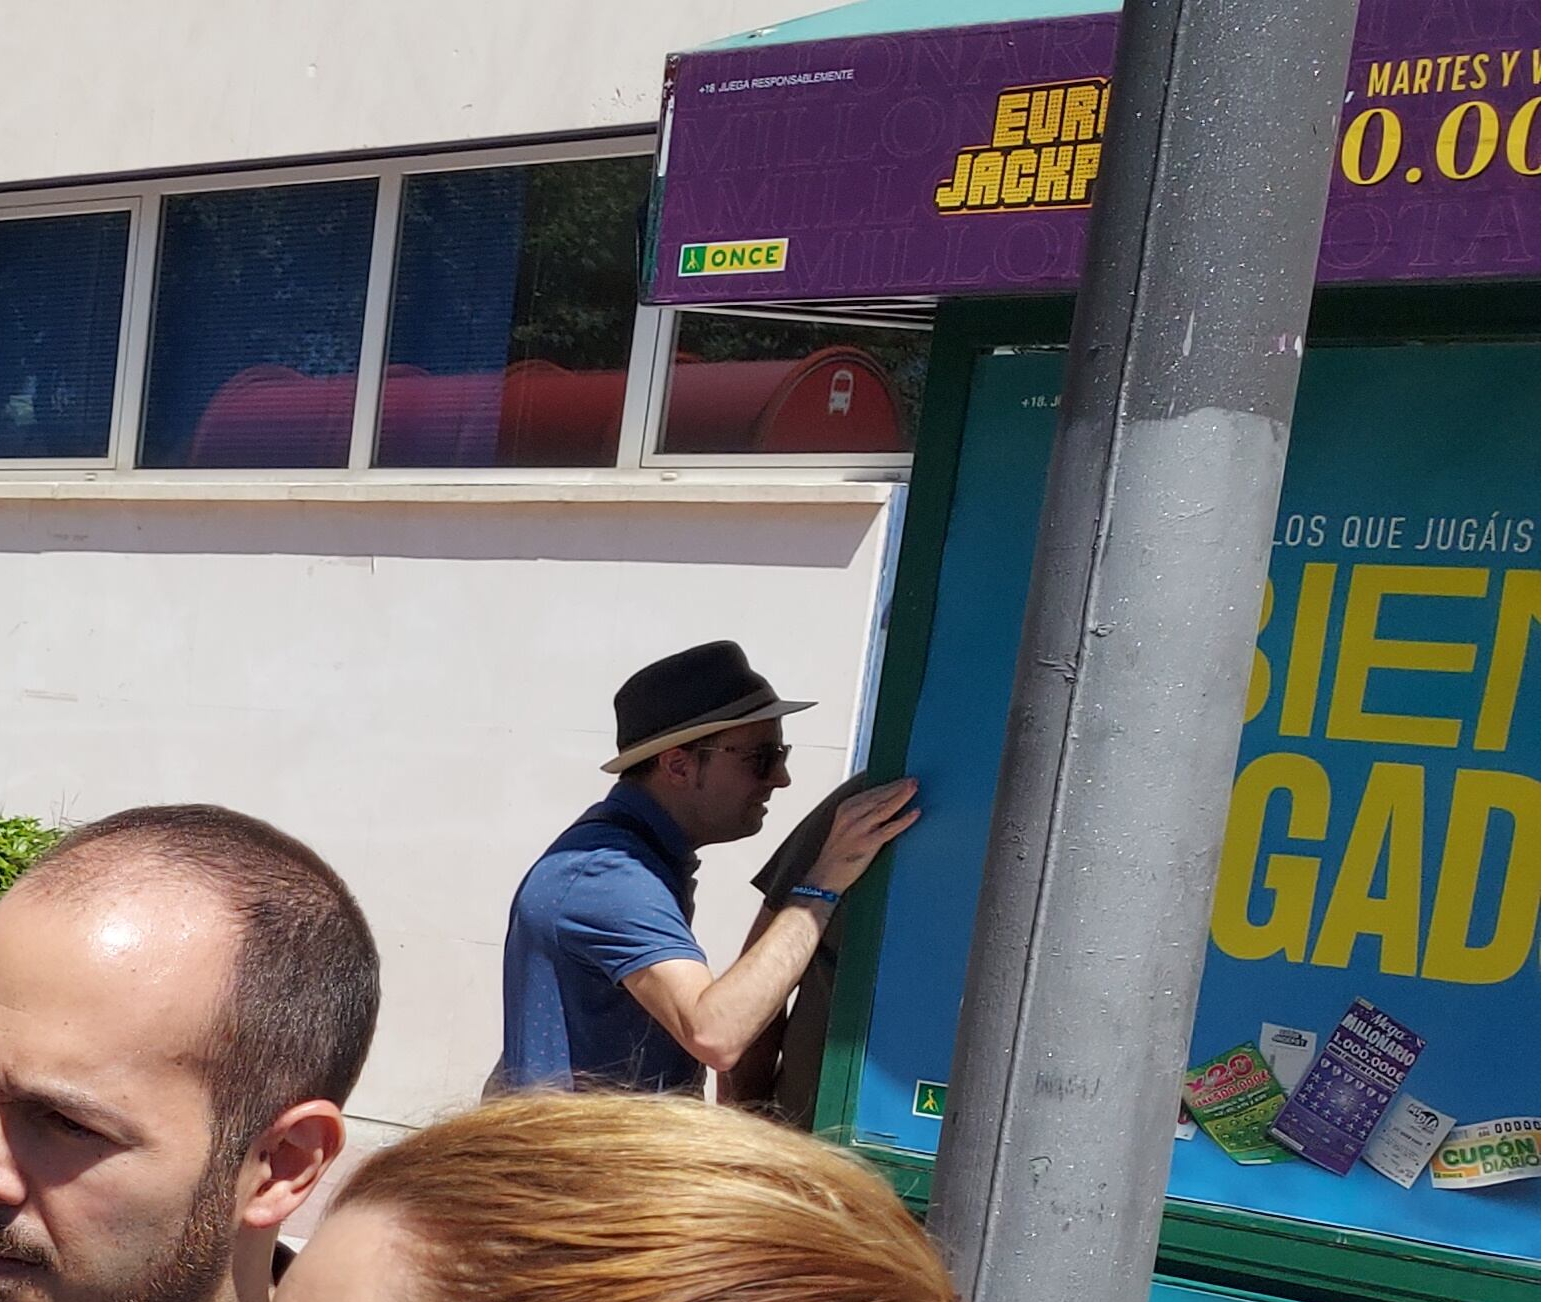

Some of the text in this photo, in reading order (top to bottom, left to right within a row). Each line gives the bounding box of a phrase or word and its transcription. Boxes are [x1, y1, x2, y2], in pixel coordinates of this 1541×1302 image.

[699, 69, 855, 94] +18 JUEGA RESPONSABLEMENTE
[1367, 54, 1490, 98] MARTES
[1501, 50, 1521, 88] Y
[711, 244, 780, 268] ONCE
[1272, 511, 1535, 553] OS QUE JUGÁIS
[1341, 1013, 1416, 1067] MILLONARIO
[1371, 1013, 1406, 1041] Mega
[1333, 1031, 1406, 1083] 1.000.000€
[1442, 1136, 1535, 1166] CUPÓN
[1482, 1154, 1541, 1174] DIARIO
